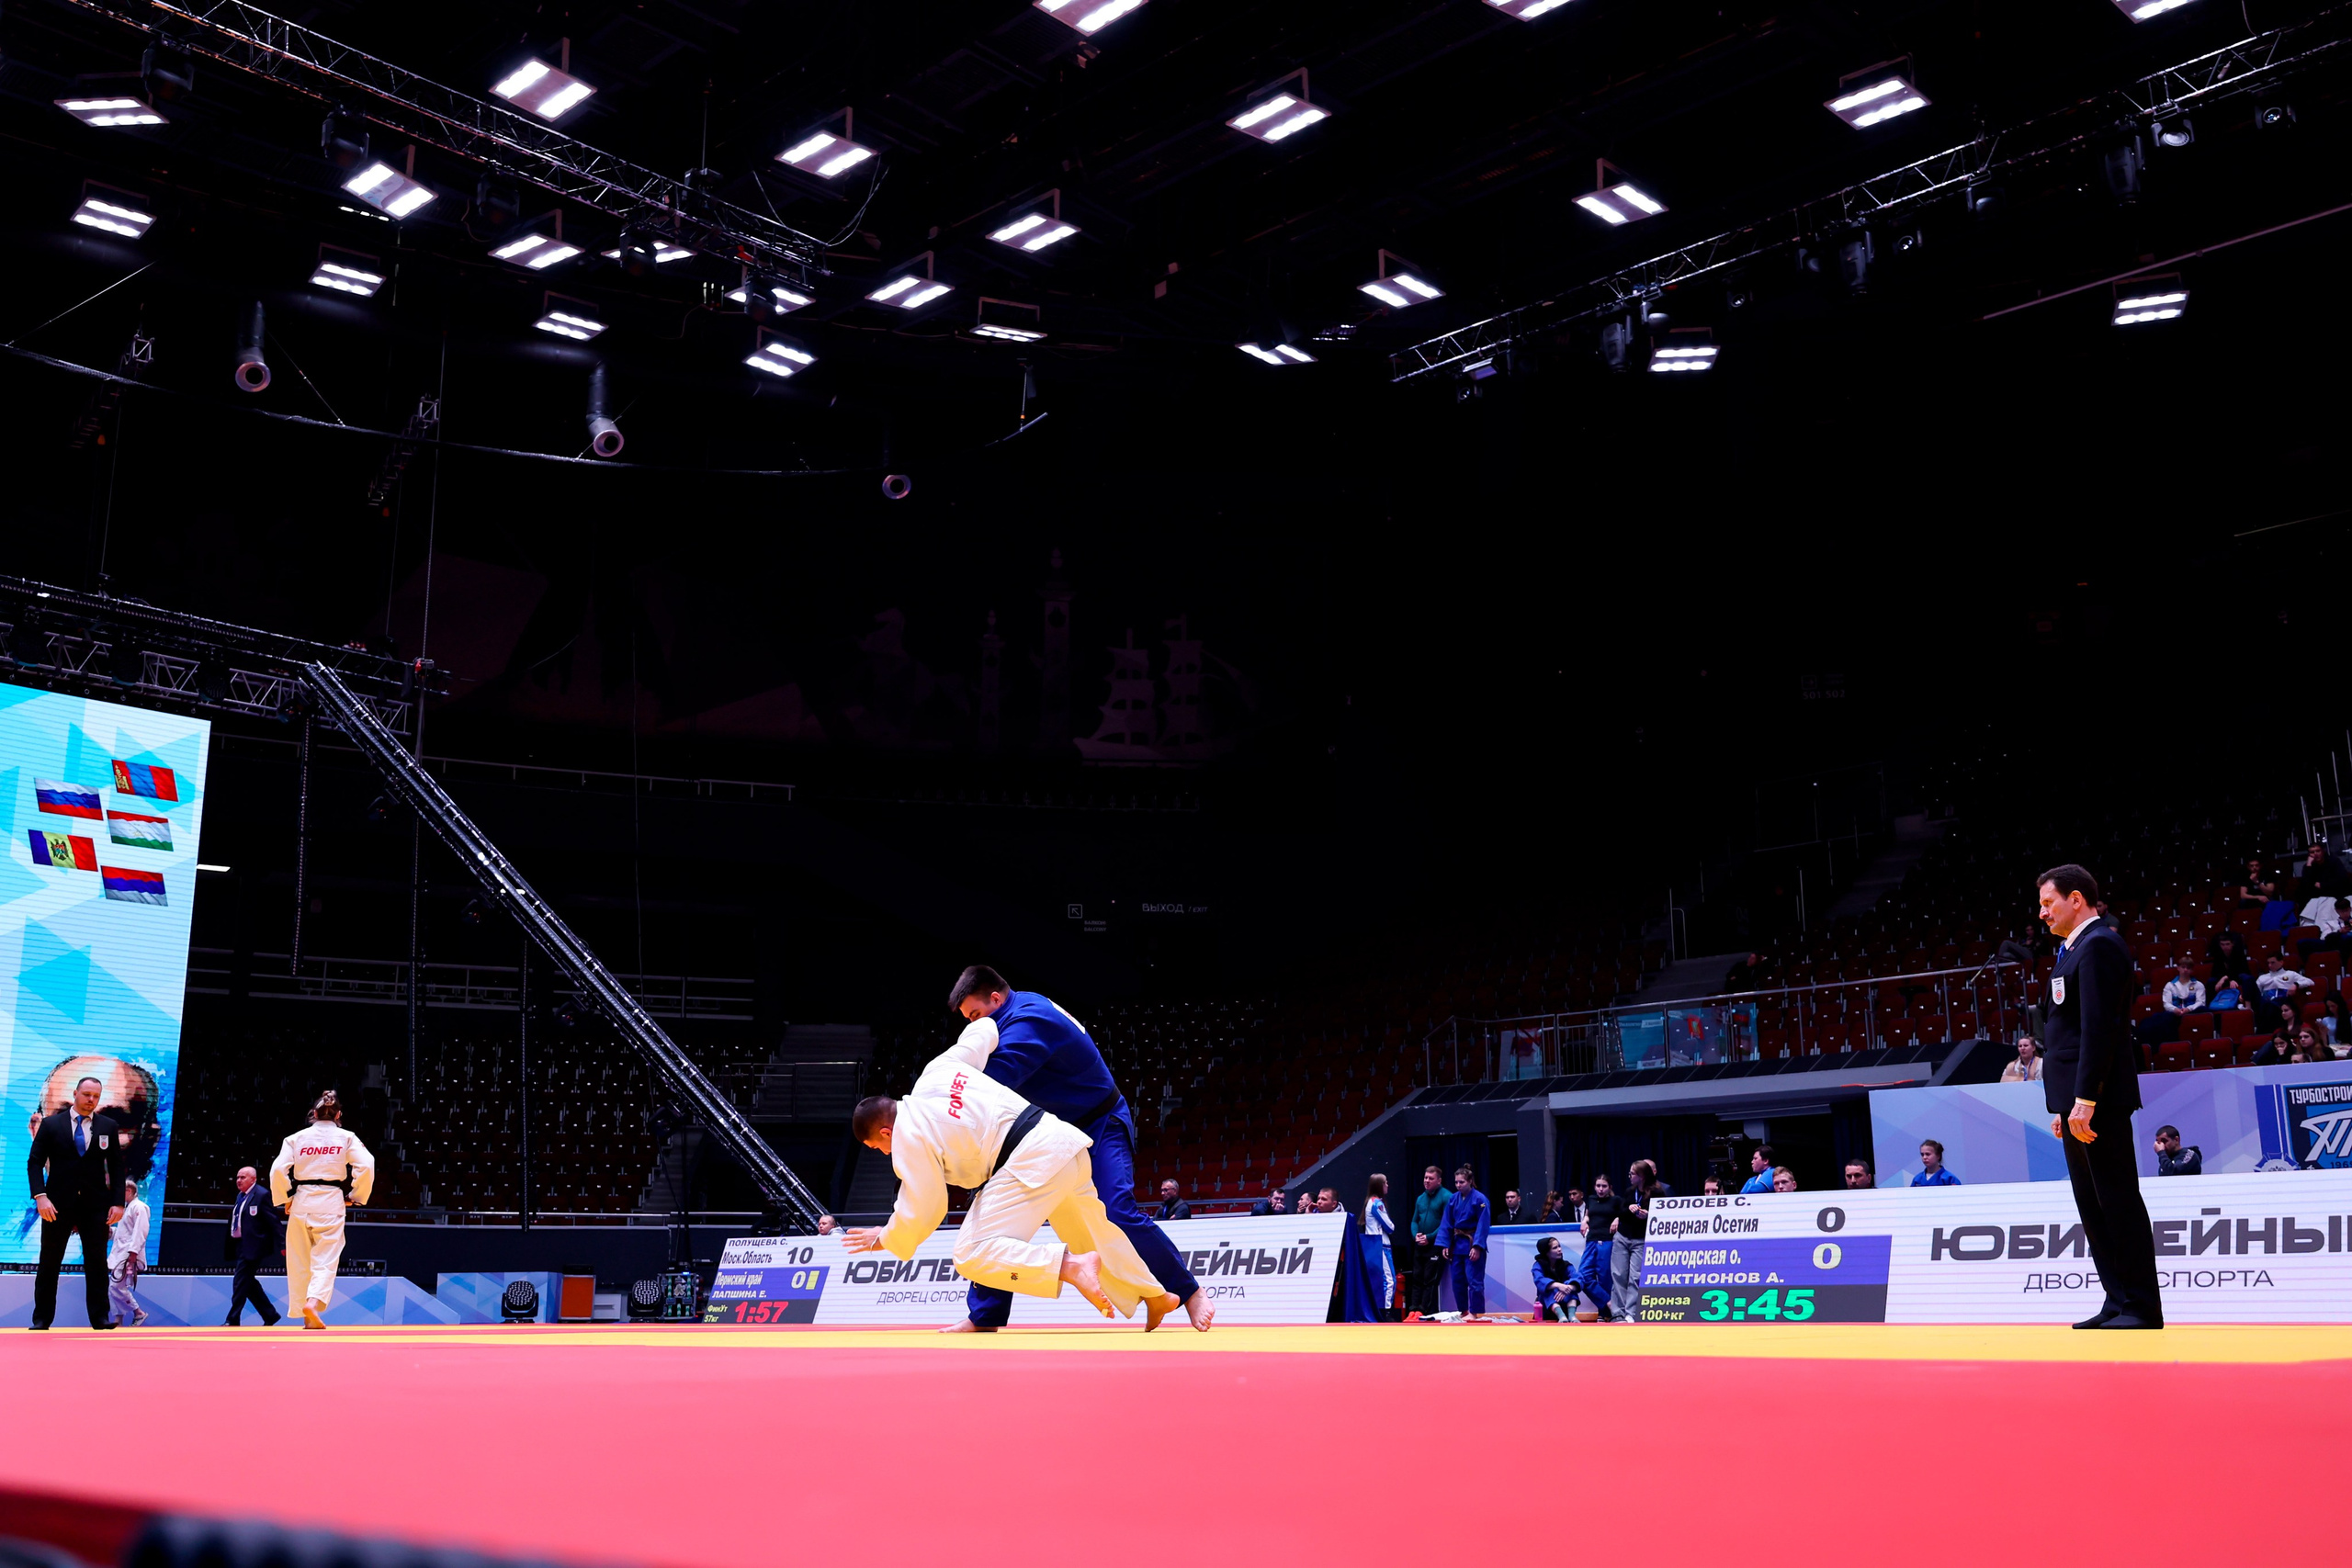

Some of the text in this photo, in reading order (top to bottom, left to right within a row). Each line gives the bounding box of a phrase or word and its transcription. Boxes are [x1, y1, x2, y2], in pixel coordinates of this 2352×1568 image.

[1142, 903, 1184, 914] ВЫХОД
[948, 1072, 968, 1119] FONBET
[300, 1145, 343, 1156] FONBET
[1656, 1196, 1751, 1210] ЗОЛОЕВ С.
[1648, 1213, 1758, 1238] Северная Осетия
[1816, 1206, 1846, 1233] 0
[1930, 1207, 2352, 1261] ЮБИЕЙНЫ
[729, 1237, 788, 1247] ПОЛУЩЕВА С.
[721, 1250, 773, 1265] Моск.Область
[787, 1247, 814, 1265] 10
[1644, 1246, 1741, 1268] Вологодская о.
[1812, 1243, 1842, 1269] 0
[715, 1270, 763, 1290] Пермский край
[1645, 1271, 1784, 1285] ЛАКТИОНОВ А.
[2024, 1269, 2274, 1293] ДВОР СПОРТА
[712, 1290, 767, 1299] ЛАПШИНА Е.
[876, 1291, 968, 1304] ДВОРЕЦ СПОР
[1204, 1286, 1245, 1299] ОРТА
[1641, 1295, 1690, 1309] Бронза
[1699, 1289, 1815, 1321] 3:45
[704, 1314, 719, 1323] 57кг
[735, 1301, 789, 1323] 1:57
[1640, 1310, 1685, 1321] 100+кг
